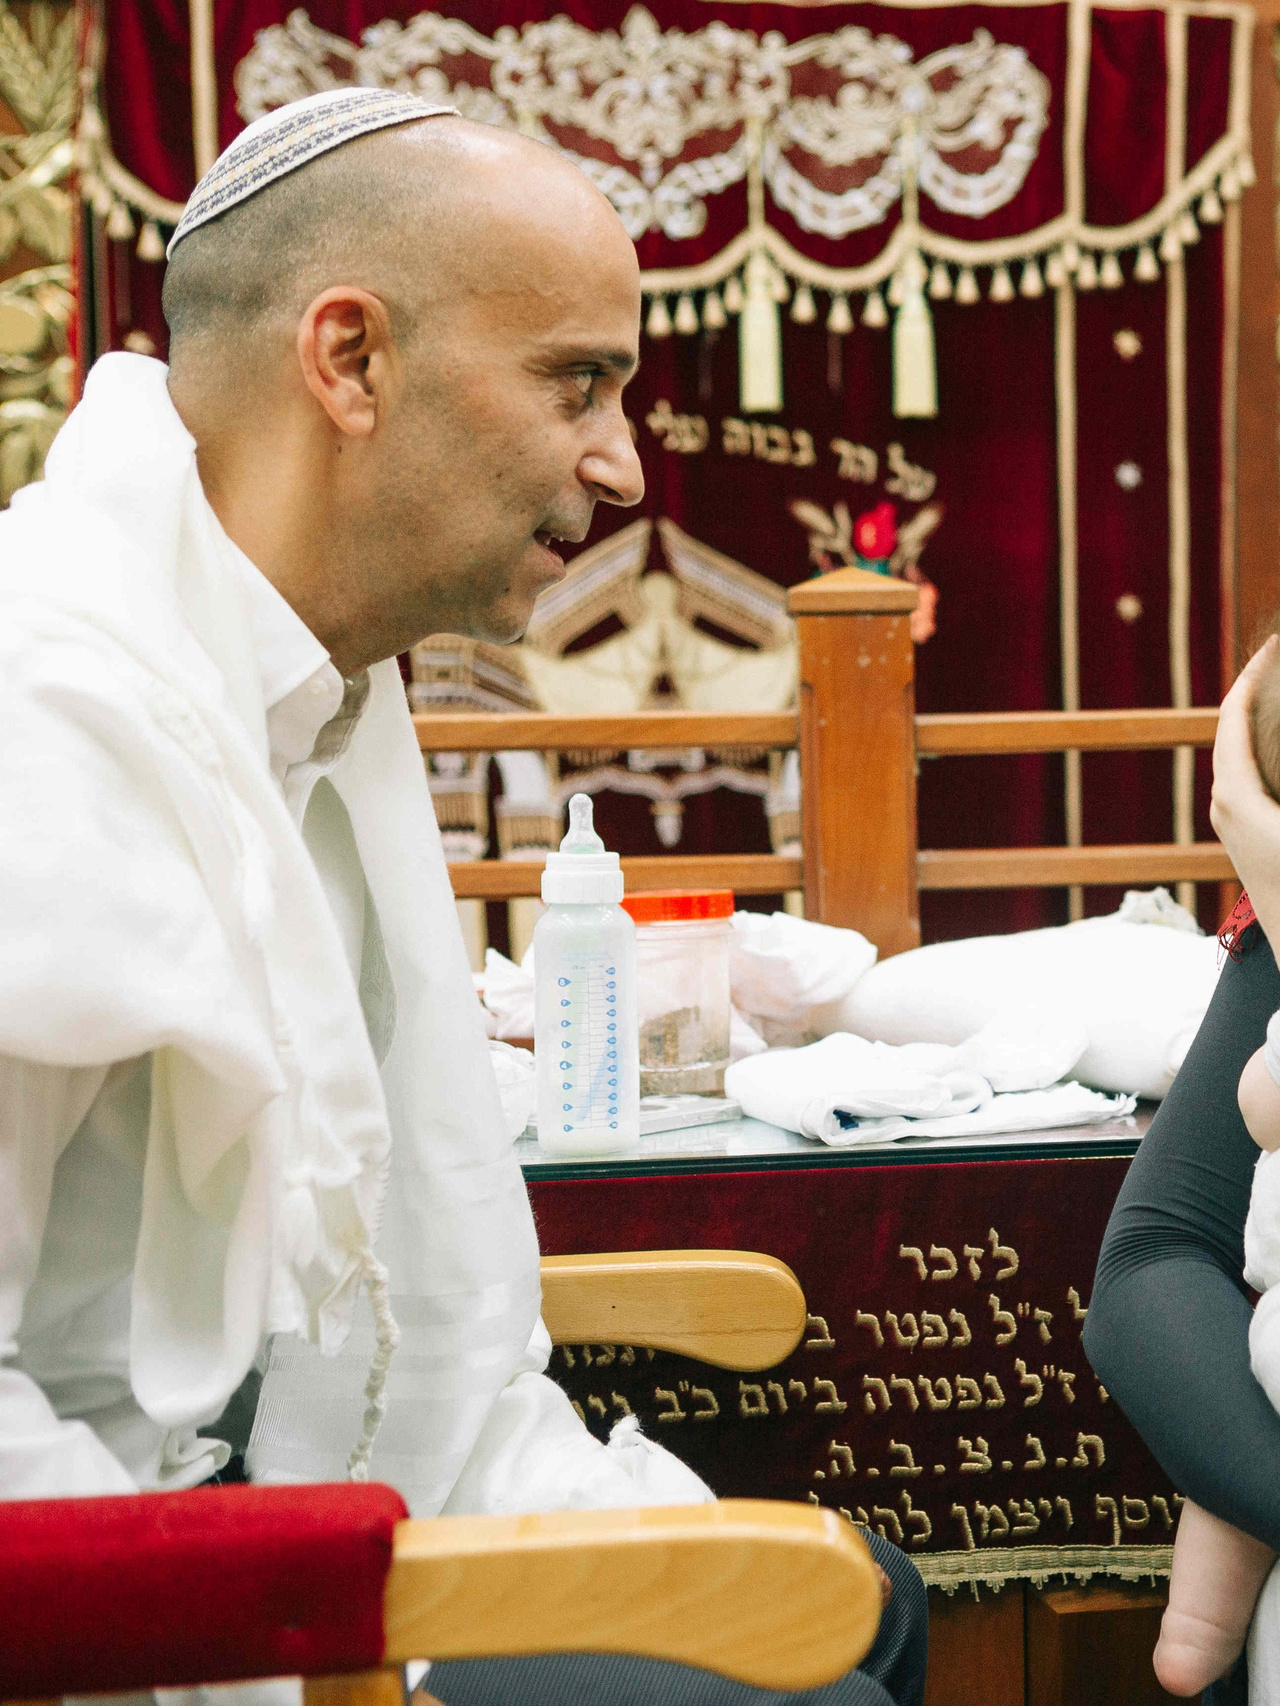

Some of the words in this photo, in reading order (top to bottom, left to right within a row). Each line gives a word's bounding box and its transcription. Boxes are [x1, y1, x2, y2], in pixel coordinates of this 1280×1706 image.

[899, 1227, 1021, 1281] לזכר
[856, 1308, 972, 1347] נפטר
[988, 1293, 1054, 1345] ז"ל
[654, 1381, 721, 1421] כ"ב
[738, 1376, 848, 1416] ביום
[862, 1371, 1007, 1411] נפטרה
[1014, 1357, 1077, 1407] ז"ל
[951, 1496, 1075, 1550] ויצמן
